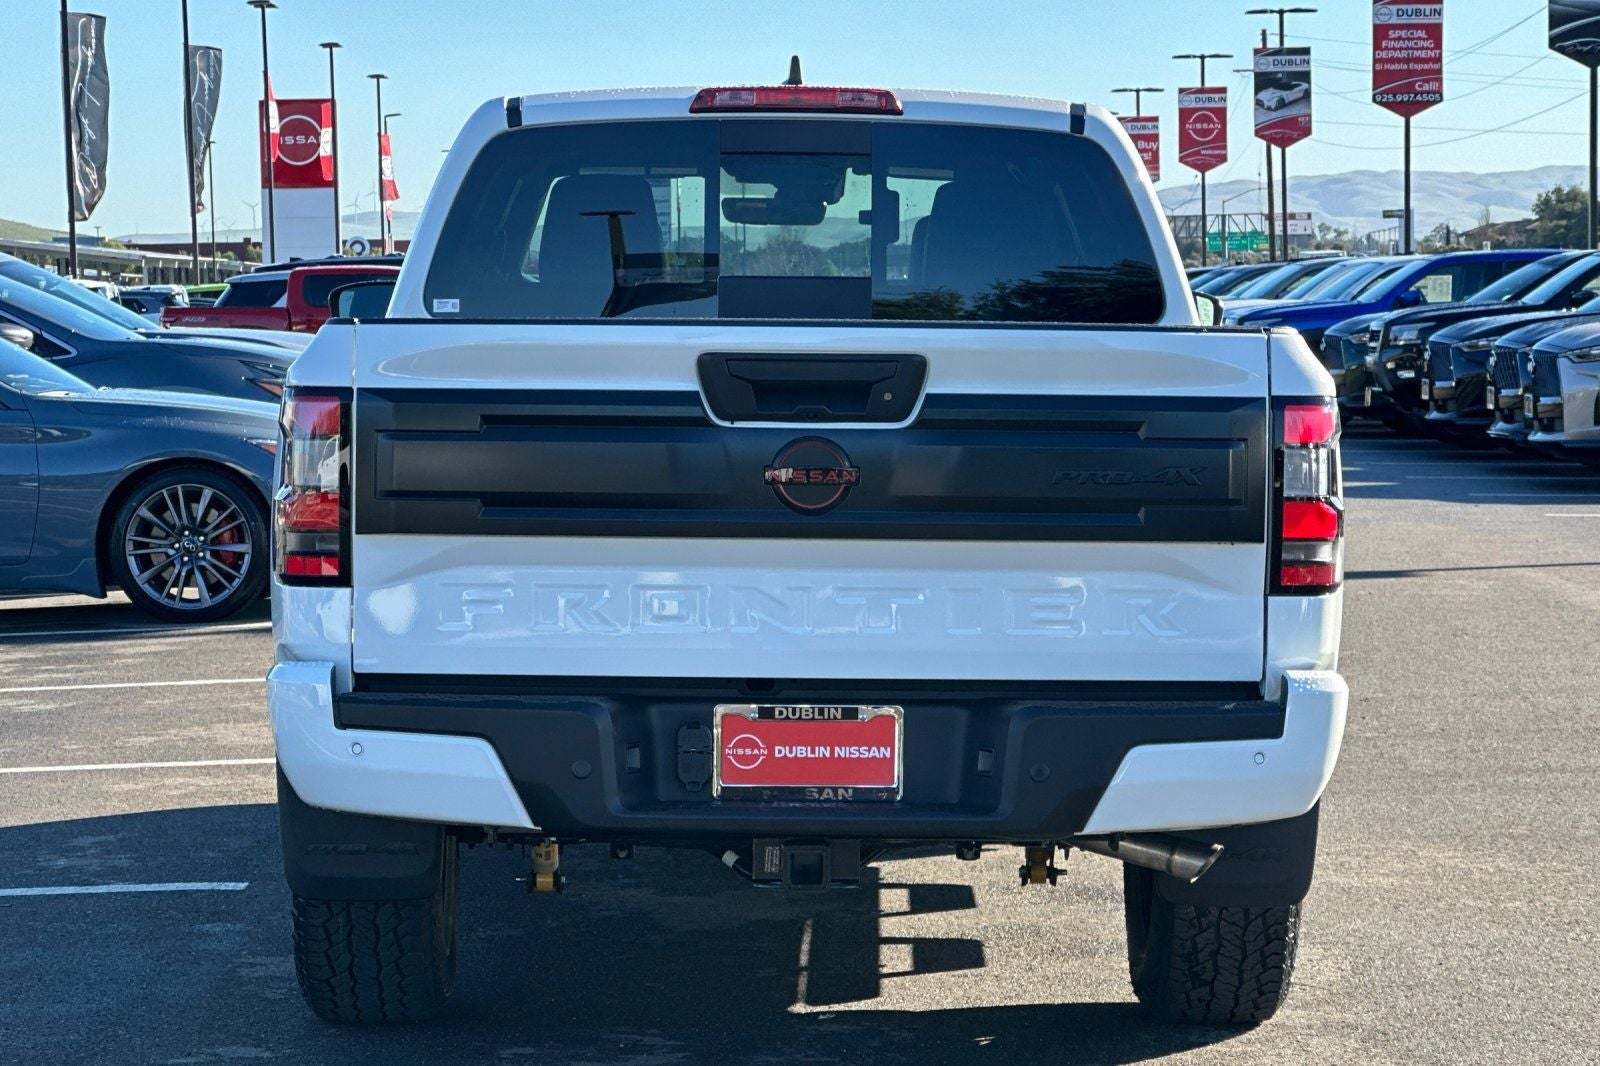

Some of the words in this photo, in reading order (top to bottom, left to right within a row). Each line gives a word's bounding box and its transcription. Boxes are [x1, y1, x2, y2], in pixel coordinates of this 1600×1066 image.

[1396, 8, 1442, 17] DUBLIN
[1388, 30, 1428, 38] SPECIAL
[1381, 40, 1434, 48] FINANCING
[1375, 50, 1441, 58] DEPARTMENT
[1272, 59, 1310, 67] DUBLIN
[1384, 62, 1407, 70] Habla
[1409, 62, 1441, 71] Español
[1415, 81, 1439, 91] Call!
[1194, 96, 1226, 104] DUBLIN
[1375, 94, 1441, 102] 925.997.4505
[280, 135, 321, 144] ISSA
[1137, 140, 1158, 151] Buy
[1140, 152, 1152, 160] rs!
[767, 469, 857, 482] NISSAN
[1052, 466, 1208, 486] PRO-4X
[436, 582, 1188, 634] FRONTIER
[774, 707, 842, 719] DUBLIN
[774, 746, 830, 758] DUBLIN
[834, 746, 891, 758] NISSAN
